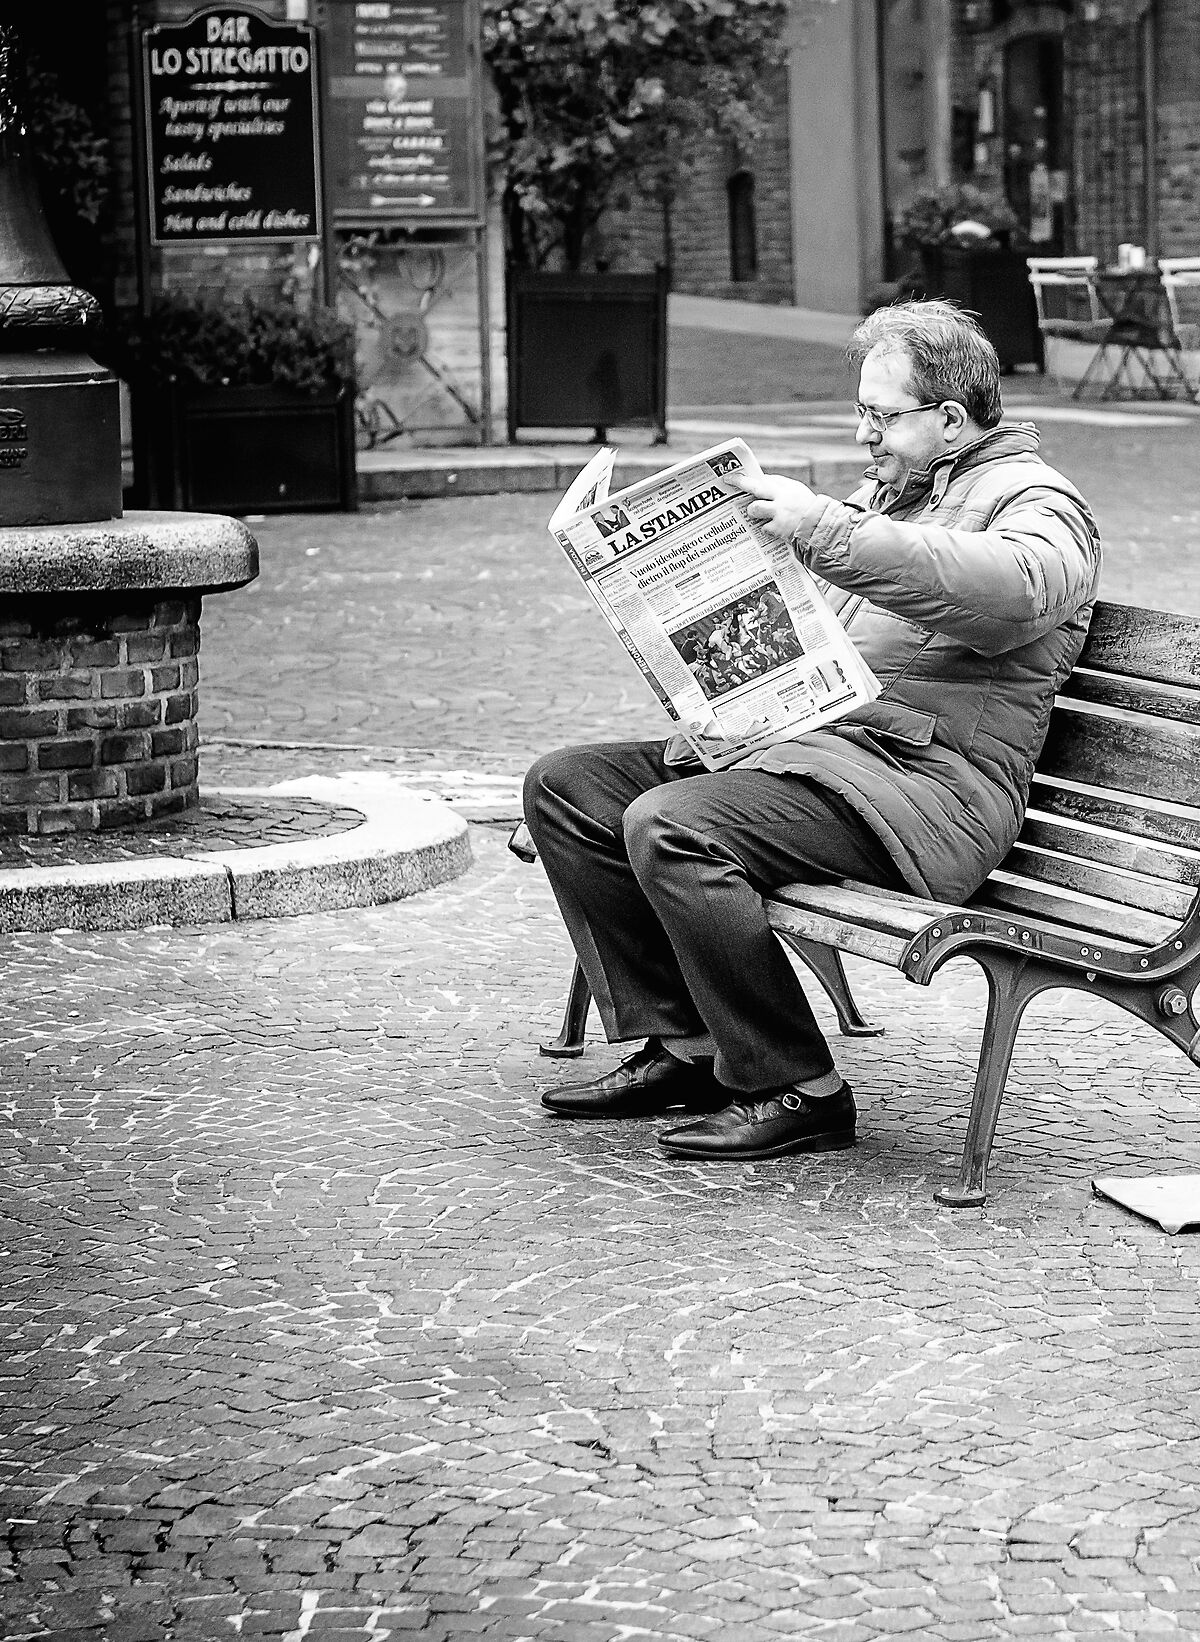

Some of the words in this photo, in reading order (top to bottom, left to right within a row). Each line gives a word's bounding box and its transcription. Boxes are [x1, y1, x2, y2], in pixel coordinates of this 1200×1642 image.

[207, 16, 251, 43] BAR
[151, 48, 182, 75] LO
[185, 46, 309, 75] STREGATTO
[160, 152, 213, 174] Salads
[196, 210, 229, 231] and
[608, 531, 643, 557] LA
[640, 485, 727, 539] STAMPA
[630, 560, 657, 579] Vuoto
[654, 538, 698, 568] ideologico
[704, 516, 738, 540] cellulari
[637, 571, 663, 590] dietro
[661, 564, 670, 576] il
[669, 557, 687, 575] flop
[686, 549, 700, 563] dei
[699, 524, 747, 556] sondaggisti
[620, 631, 650, 673] PIEMONTESE
